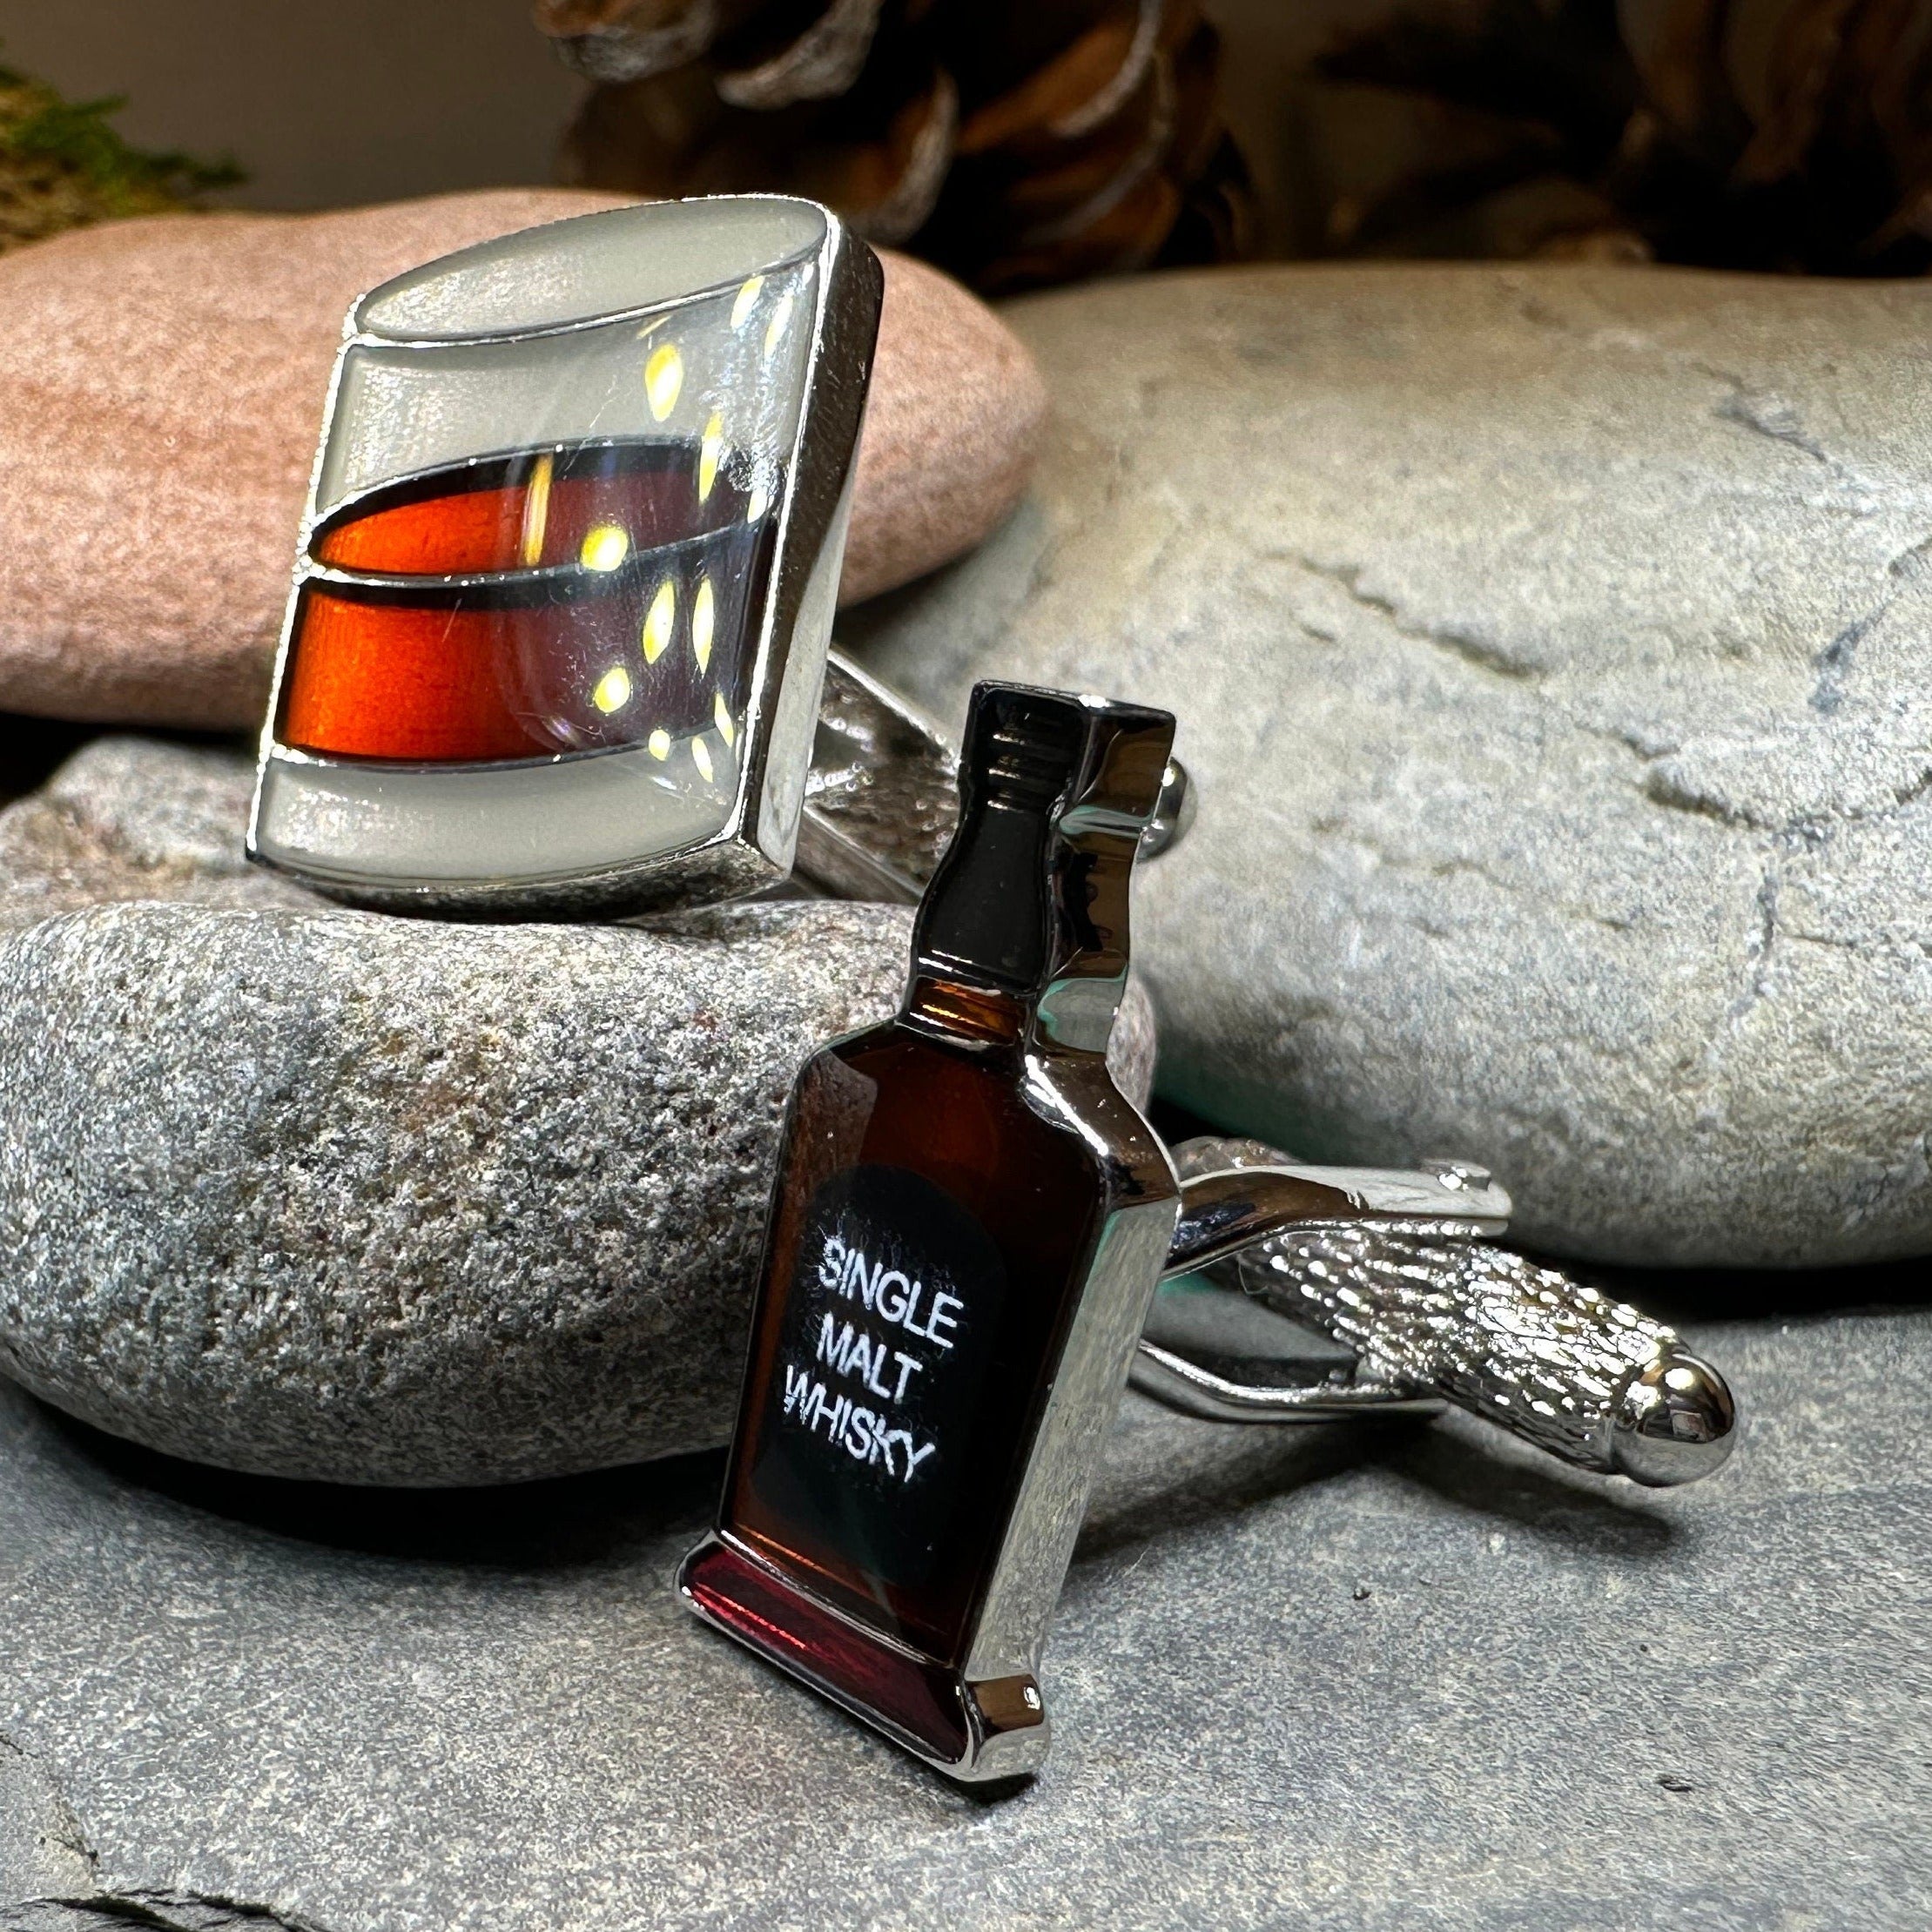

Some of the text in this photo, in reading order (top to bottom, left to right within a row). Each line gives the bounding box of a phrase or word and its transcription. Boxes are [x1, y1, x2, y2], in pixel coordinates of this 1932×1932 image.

[818, 1235, 965, 1349] SINGLE
[817, 1311, 924, 1404] MALT
[784, 1364, 936, 1483] WHISKY
